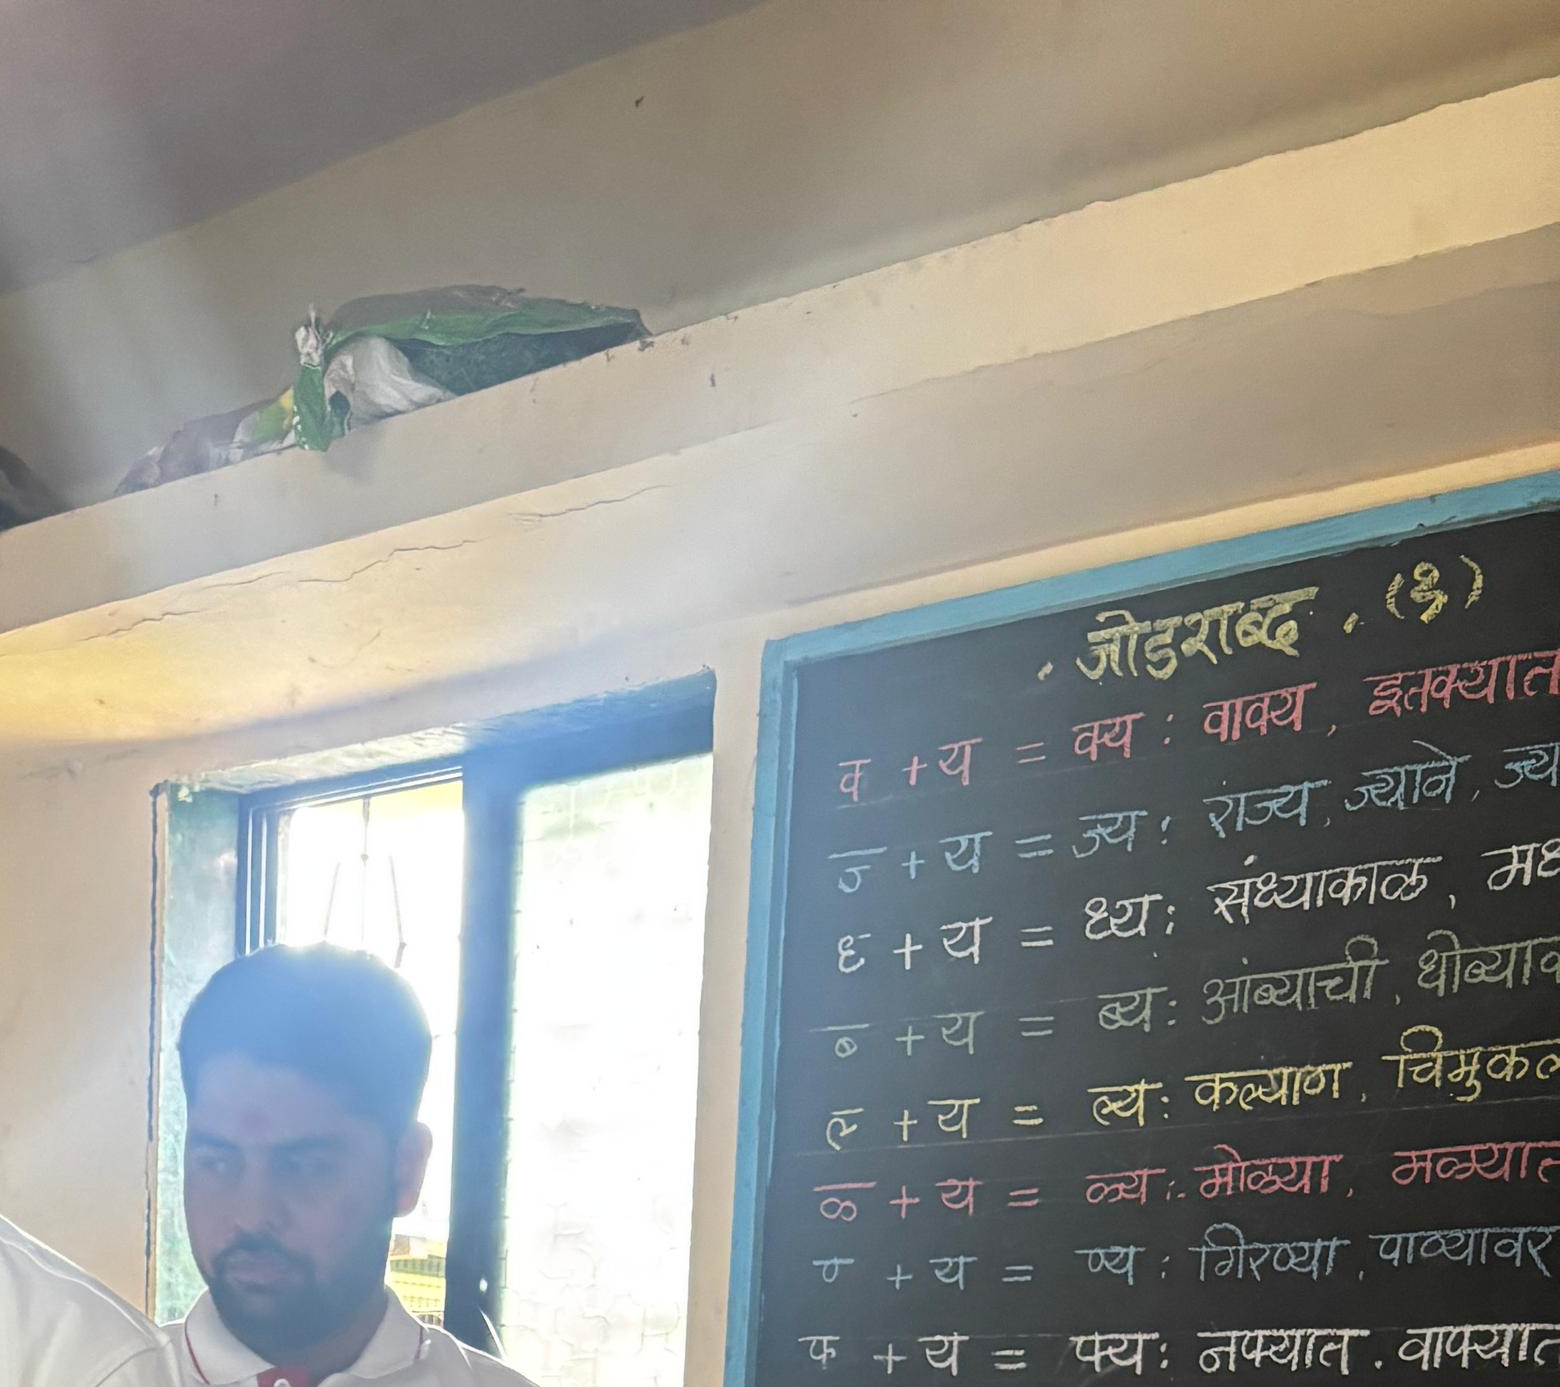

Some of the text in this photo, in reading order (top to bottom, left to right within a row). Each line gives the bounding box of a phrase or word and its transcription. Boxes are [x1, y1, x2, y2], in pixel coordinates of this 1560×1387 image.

[937, 737, 984, 787] य
[938, 830, 993, 875] य
[939, 916, 994, 965] य
[932, 1010, 985, 1056] य
[928, 1097, 982, 1139] य
[935, 1176, 984, 1217] य
[929, 1256, 978, 1291] य
[917, 1331, 970, 1376] य
